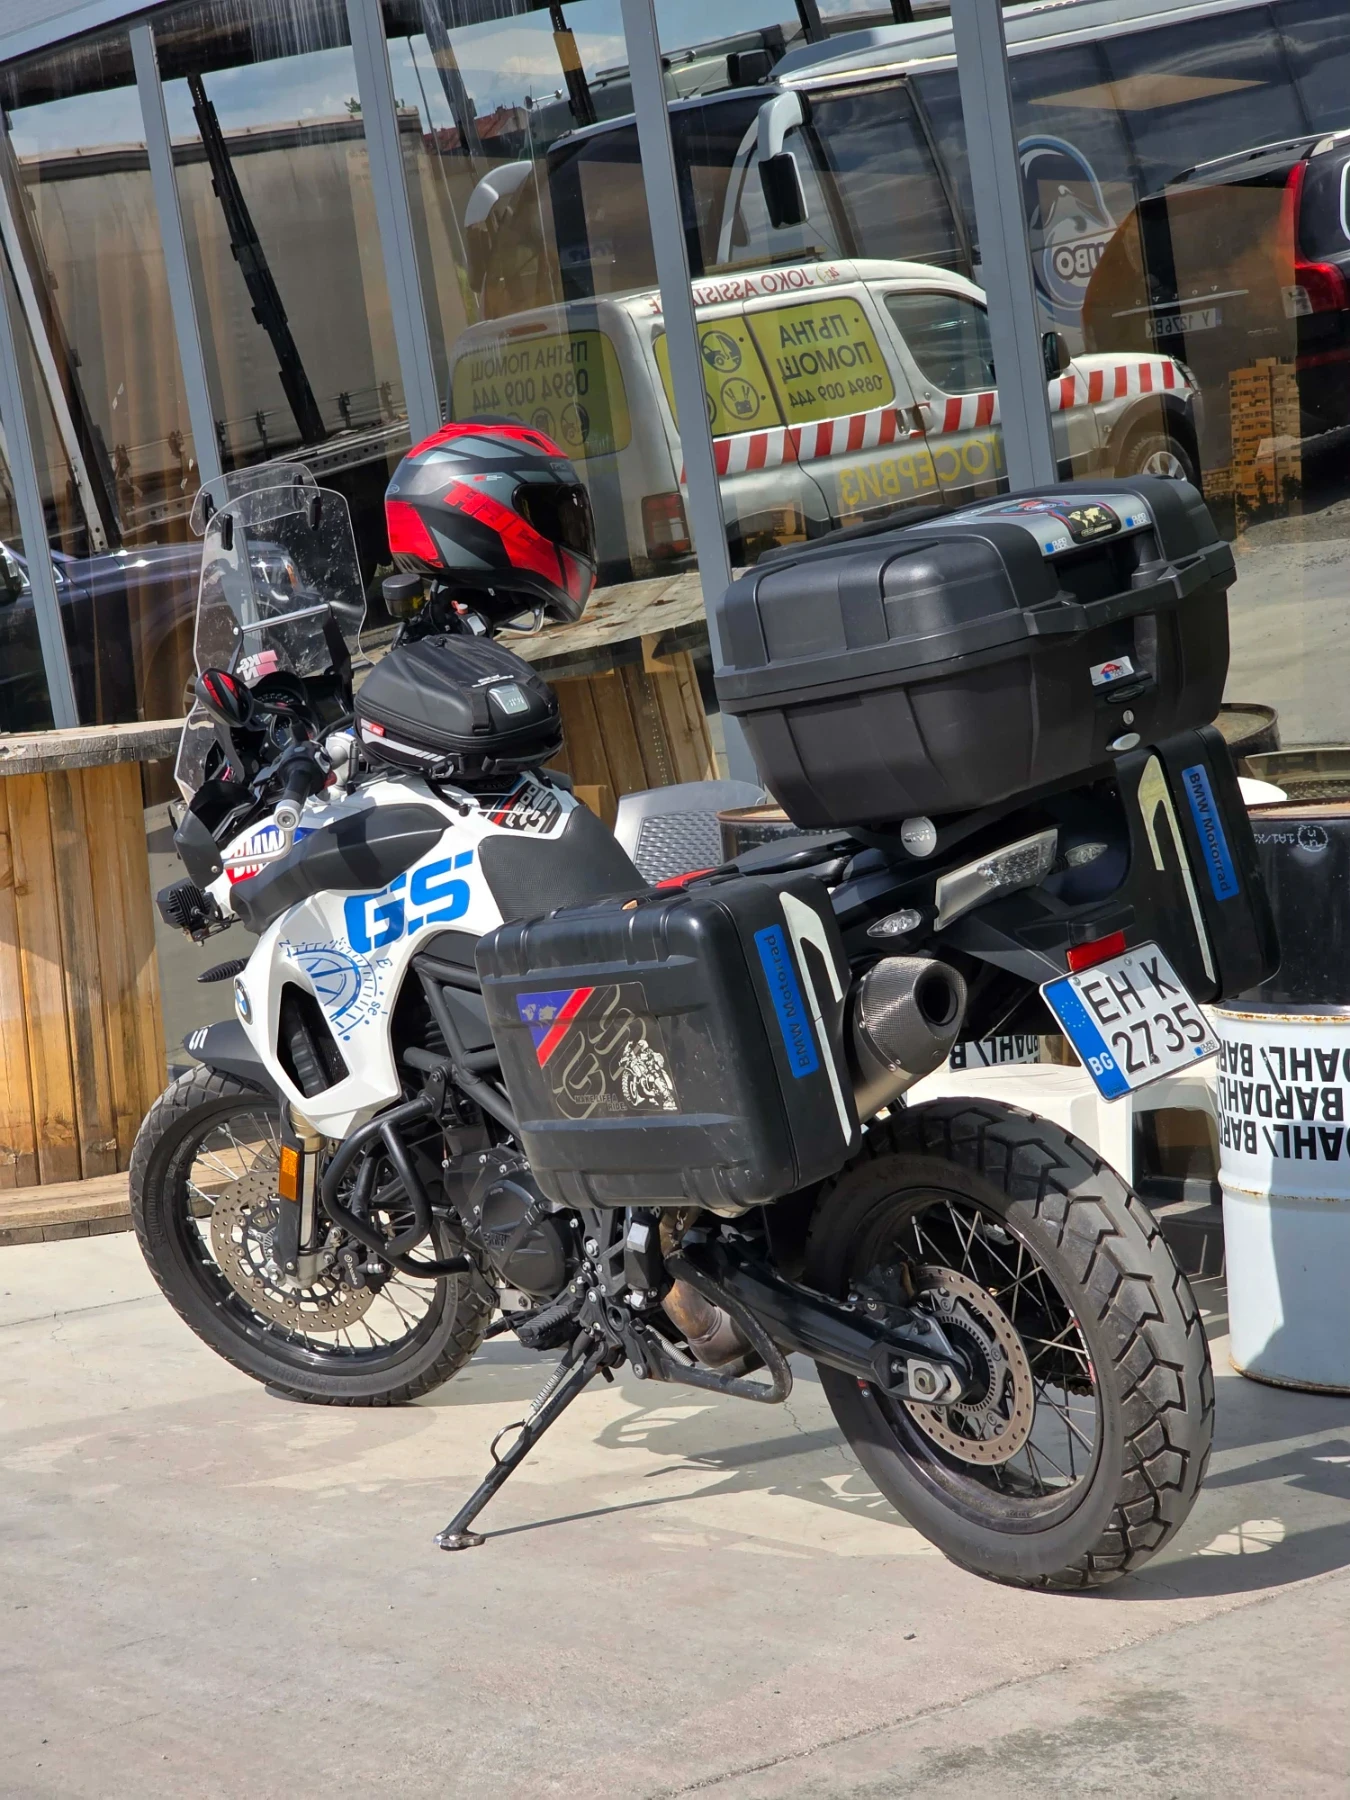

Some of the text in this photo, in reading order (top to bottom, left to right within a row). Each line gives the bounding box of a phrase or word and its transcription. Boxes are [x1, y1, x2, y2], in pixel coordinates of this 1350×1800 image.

[1188, 772, 1232, 893] BMW Motorrad
[343, 849, 474, 954] GS
[763, 933, 810, 1068] BMW Motorrad
[1080, 956, 1181, 1027] EH K
[1087, 1051, 1115, 1077] BG
[1110, 1002, 1206, 1076] 2735
[1217, 1039, 1254, 1078] BAR
[1219, 1074, 1345, 1122] BARDAHL
[1218, 1114, 1258, 1155] BAR
